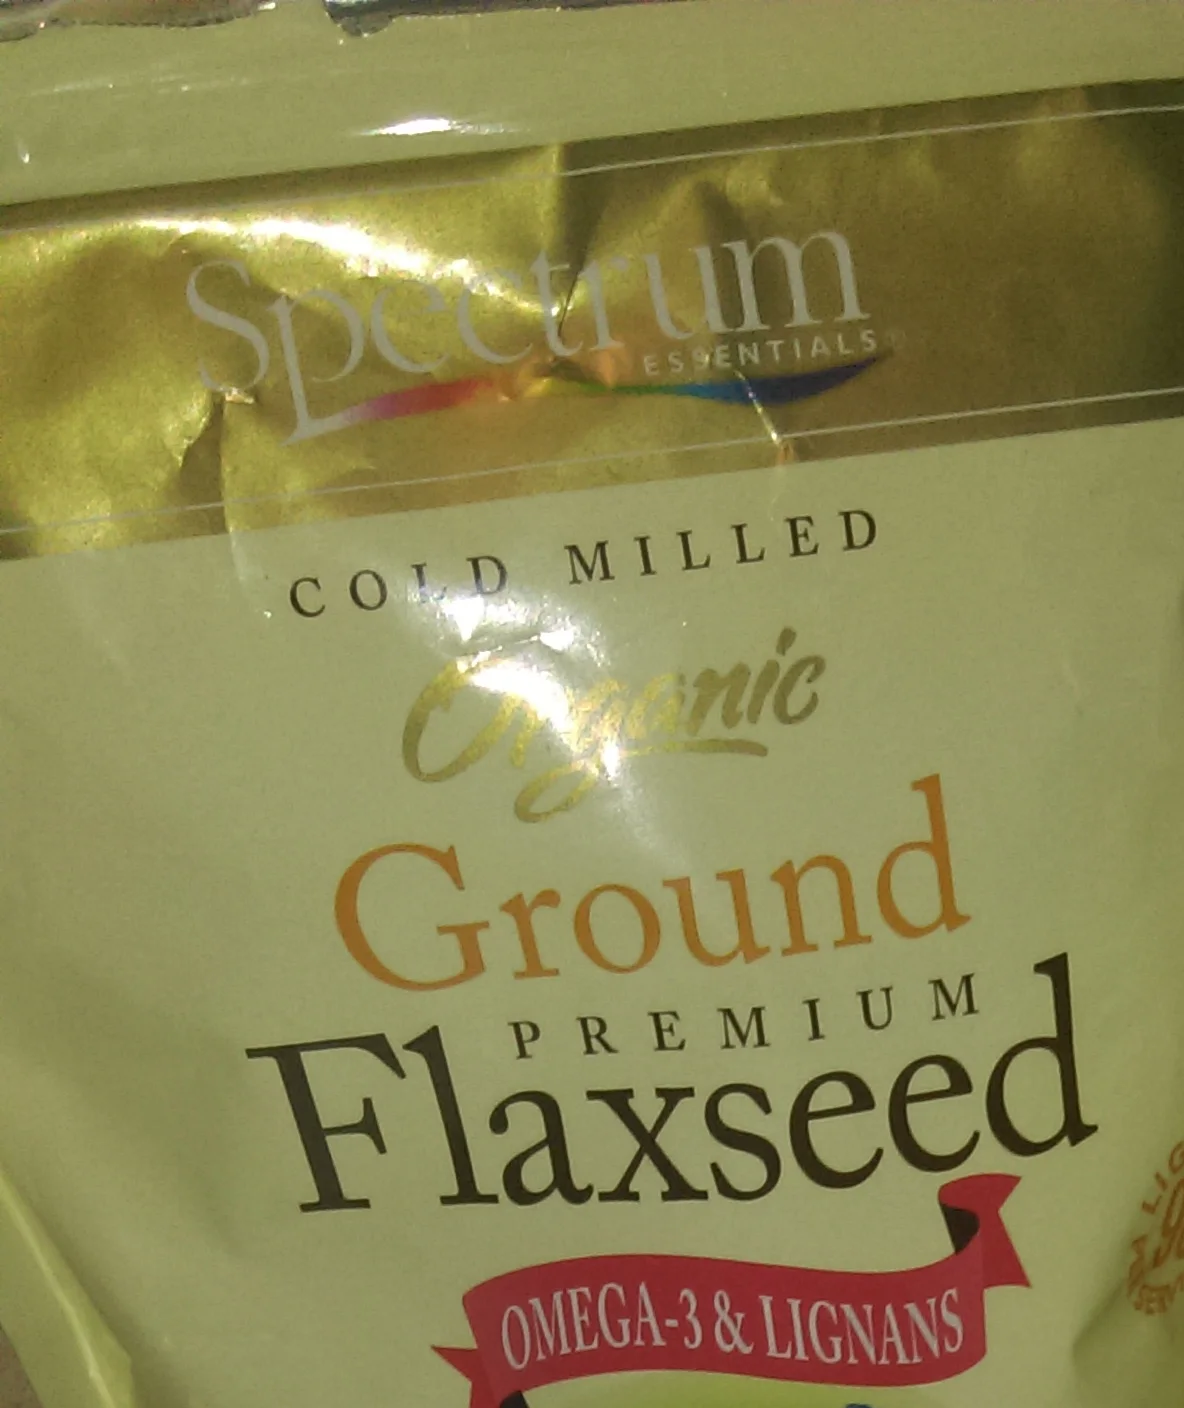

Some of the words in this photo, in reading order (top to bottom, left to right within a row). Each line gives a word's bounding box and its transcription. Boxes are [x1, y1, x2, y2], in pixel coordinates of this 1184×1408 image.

[186, 229, 872, 447] Spectrum
[642, 331, 878, 378] ESSENTIALS
[289, 555, 508, 618] COLD
[564, 508, 878, 586] MILLED
[402, 627, 826, 823] Organic
[334, 773, 971, 991] Ground
[246, 952, 1098, 1212] Flaxseed
[508, 972, 979, 1060] PREMIUM
[501, 1281, 702, 1372] OMEGA-3
[713, 1289, 754, 1355] &
[758, 1289, 965, 1366] LIGNANS
